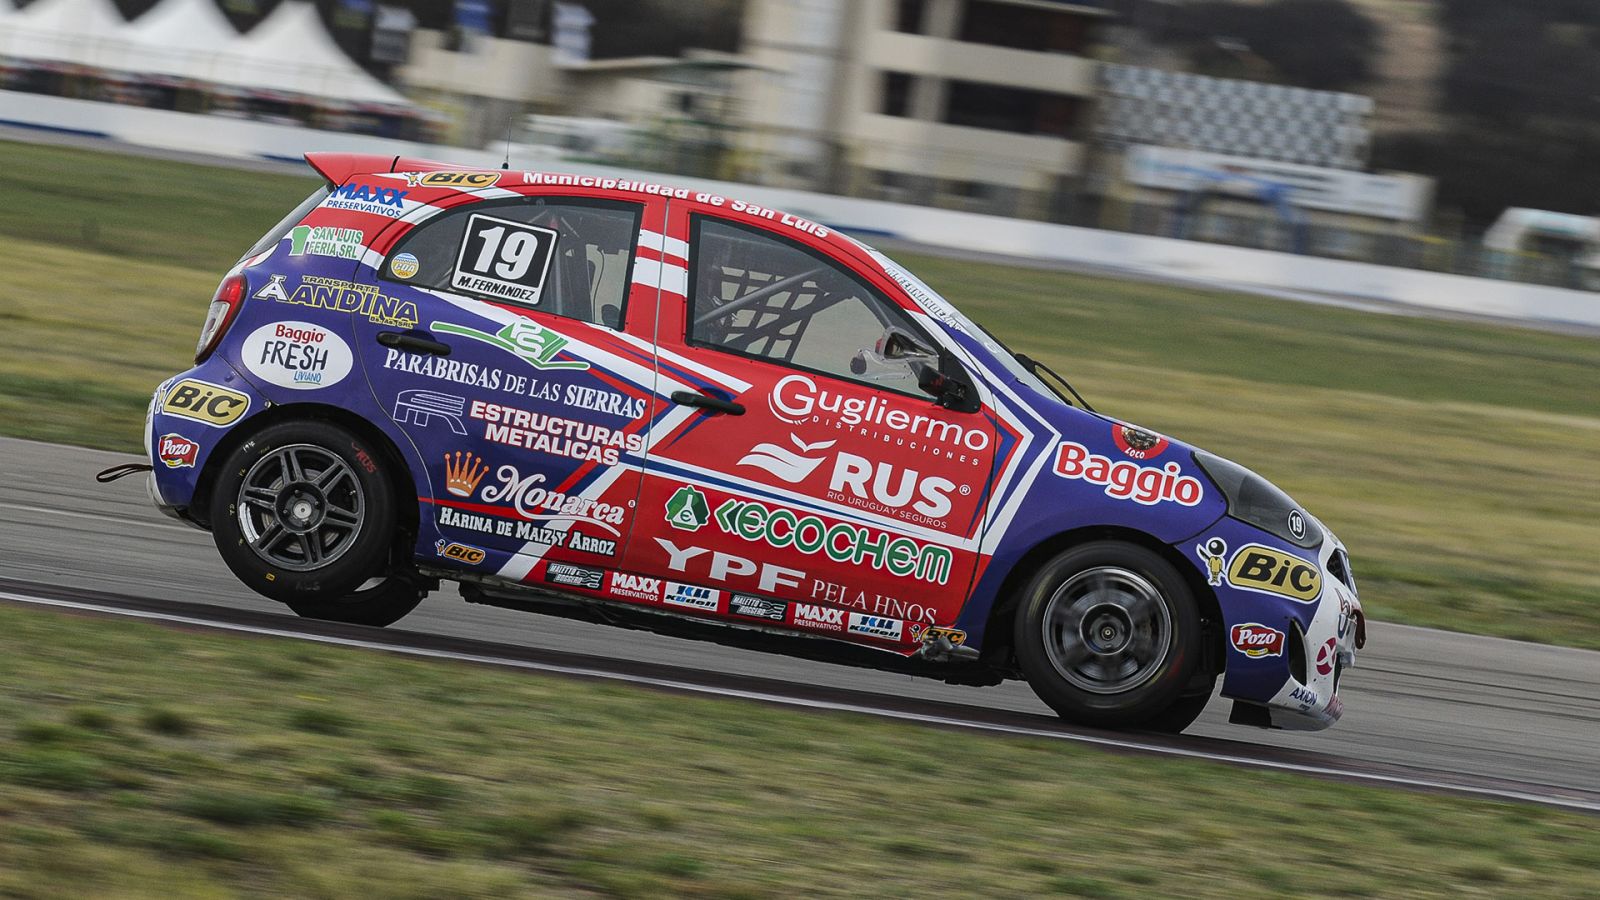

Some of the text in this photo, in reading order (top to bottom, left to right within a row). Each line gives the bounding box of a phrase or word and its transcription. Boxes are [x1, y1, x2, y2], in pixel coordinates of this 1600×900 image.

[327, 200, 401, 218] PRESERVATIVOS
[331, 182, 410, 208] MAXX
[522, 171, 830, 238] Municipalidad de San Luis
[312, 227, 363, 244] SAN LUIS
[340, 245, 358, 258] SRL
[474, 226, 538, 280] 19
[302, 275, 379, 293] TRANSPORTE
[457, 275, 535, 301] M.FERNANDEZ
[289, 284, 419, 324] ANDINA
[275, 324, 325, 344] Baggio
[260, 341, 328, 371] FRESH
[384, 348, 647, 419] PARABRISAS DE LAS SIERRAS
[470, 400, 643, 452] ESTRUCTURAS
[770, 374, 989, 451] Gugliermo
[485, 422, 620, 467] METALICAS
[812, 415, 980, 467] DISTRIBUCIONES
[829, 451, 957, 519] RUS
[1055, 443, 1201, 505] Baggio
[481, 465, 625, 528] Monarca
[827, 490, 948, 530] RIO URUGUAY SEGUROS
[556, 530, 568, 547] Y
[1291, 514, 1303, 533] 19
[653, 537, 807, 593] YPF
[610, 587, 659, 602] PRESERVATIVOS
[611, 572, 662, 595] MAXX
[811, 579, 867, 613] PELA
[793, 618, 842, 632] PRESERVATIVOS
[795, 603, 845, 625] MAXX
